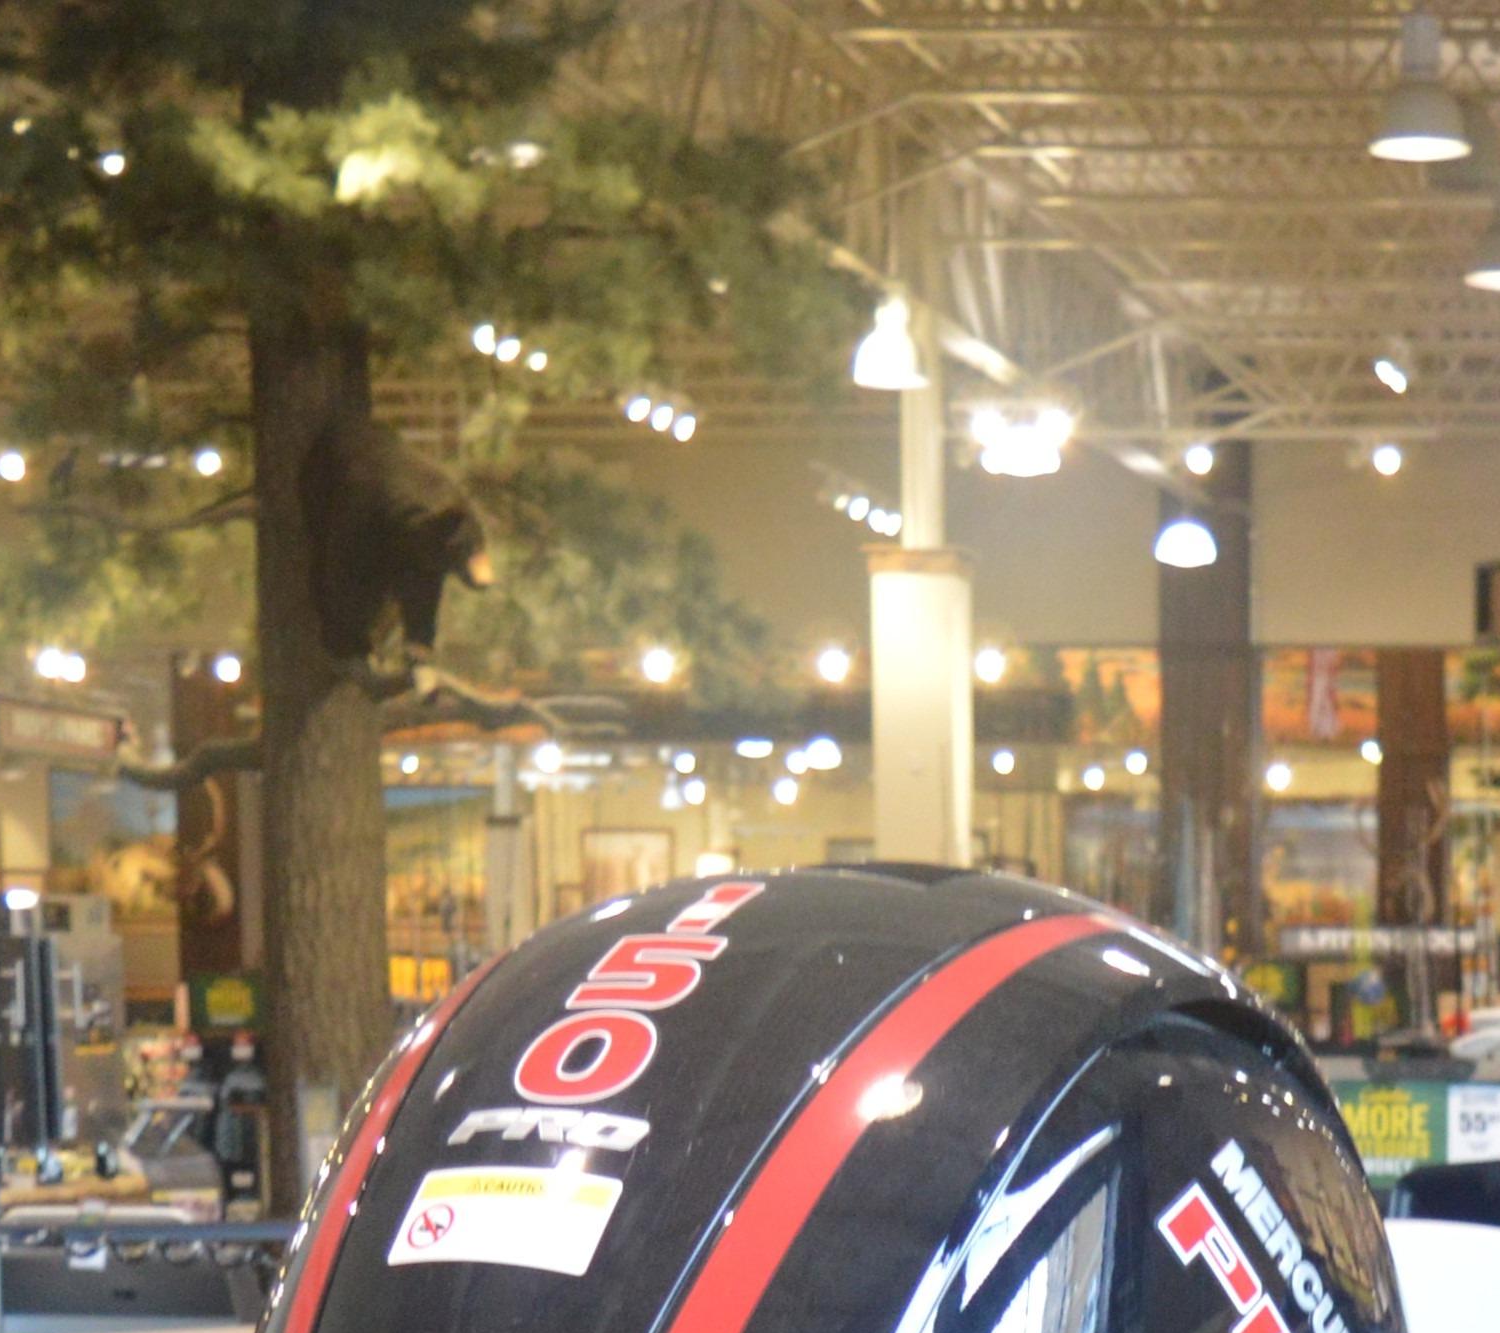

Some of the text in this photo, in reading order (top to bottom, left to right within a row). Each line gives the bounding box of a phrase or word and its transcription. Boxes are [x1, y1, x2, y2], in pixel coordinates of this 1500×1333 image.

[513, 881, 766, 1105] 150
[446, 1105, 651, 1152] PRO
[1343, 1103, 1430, 1138] MORE
